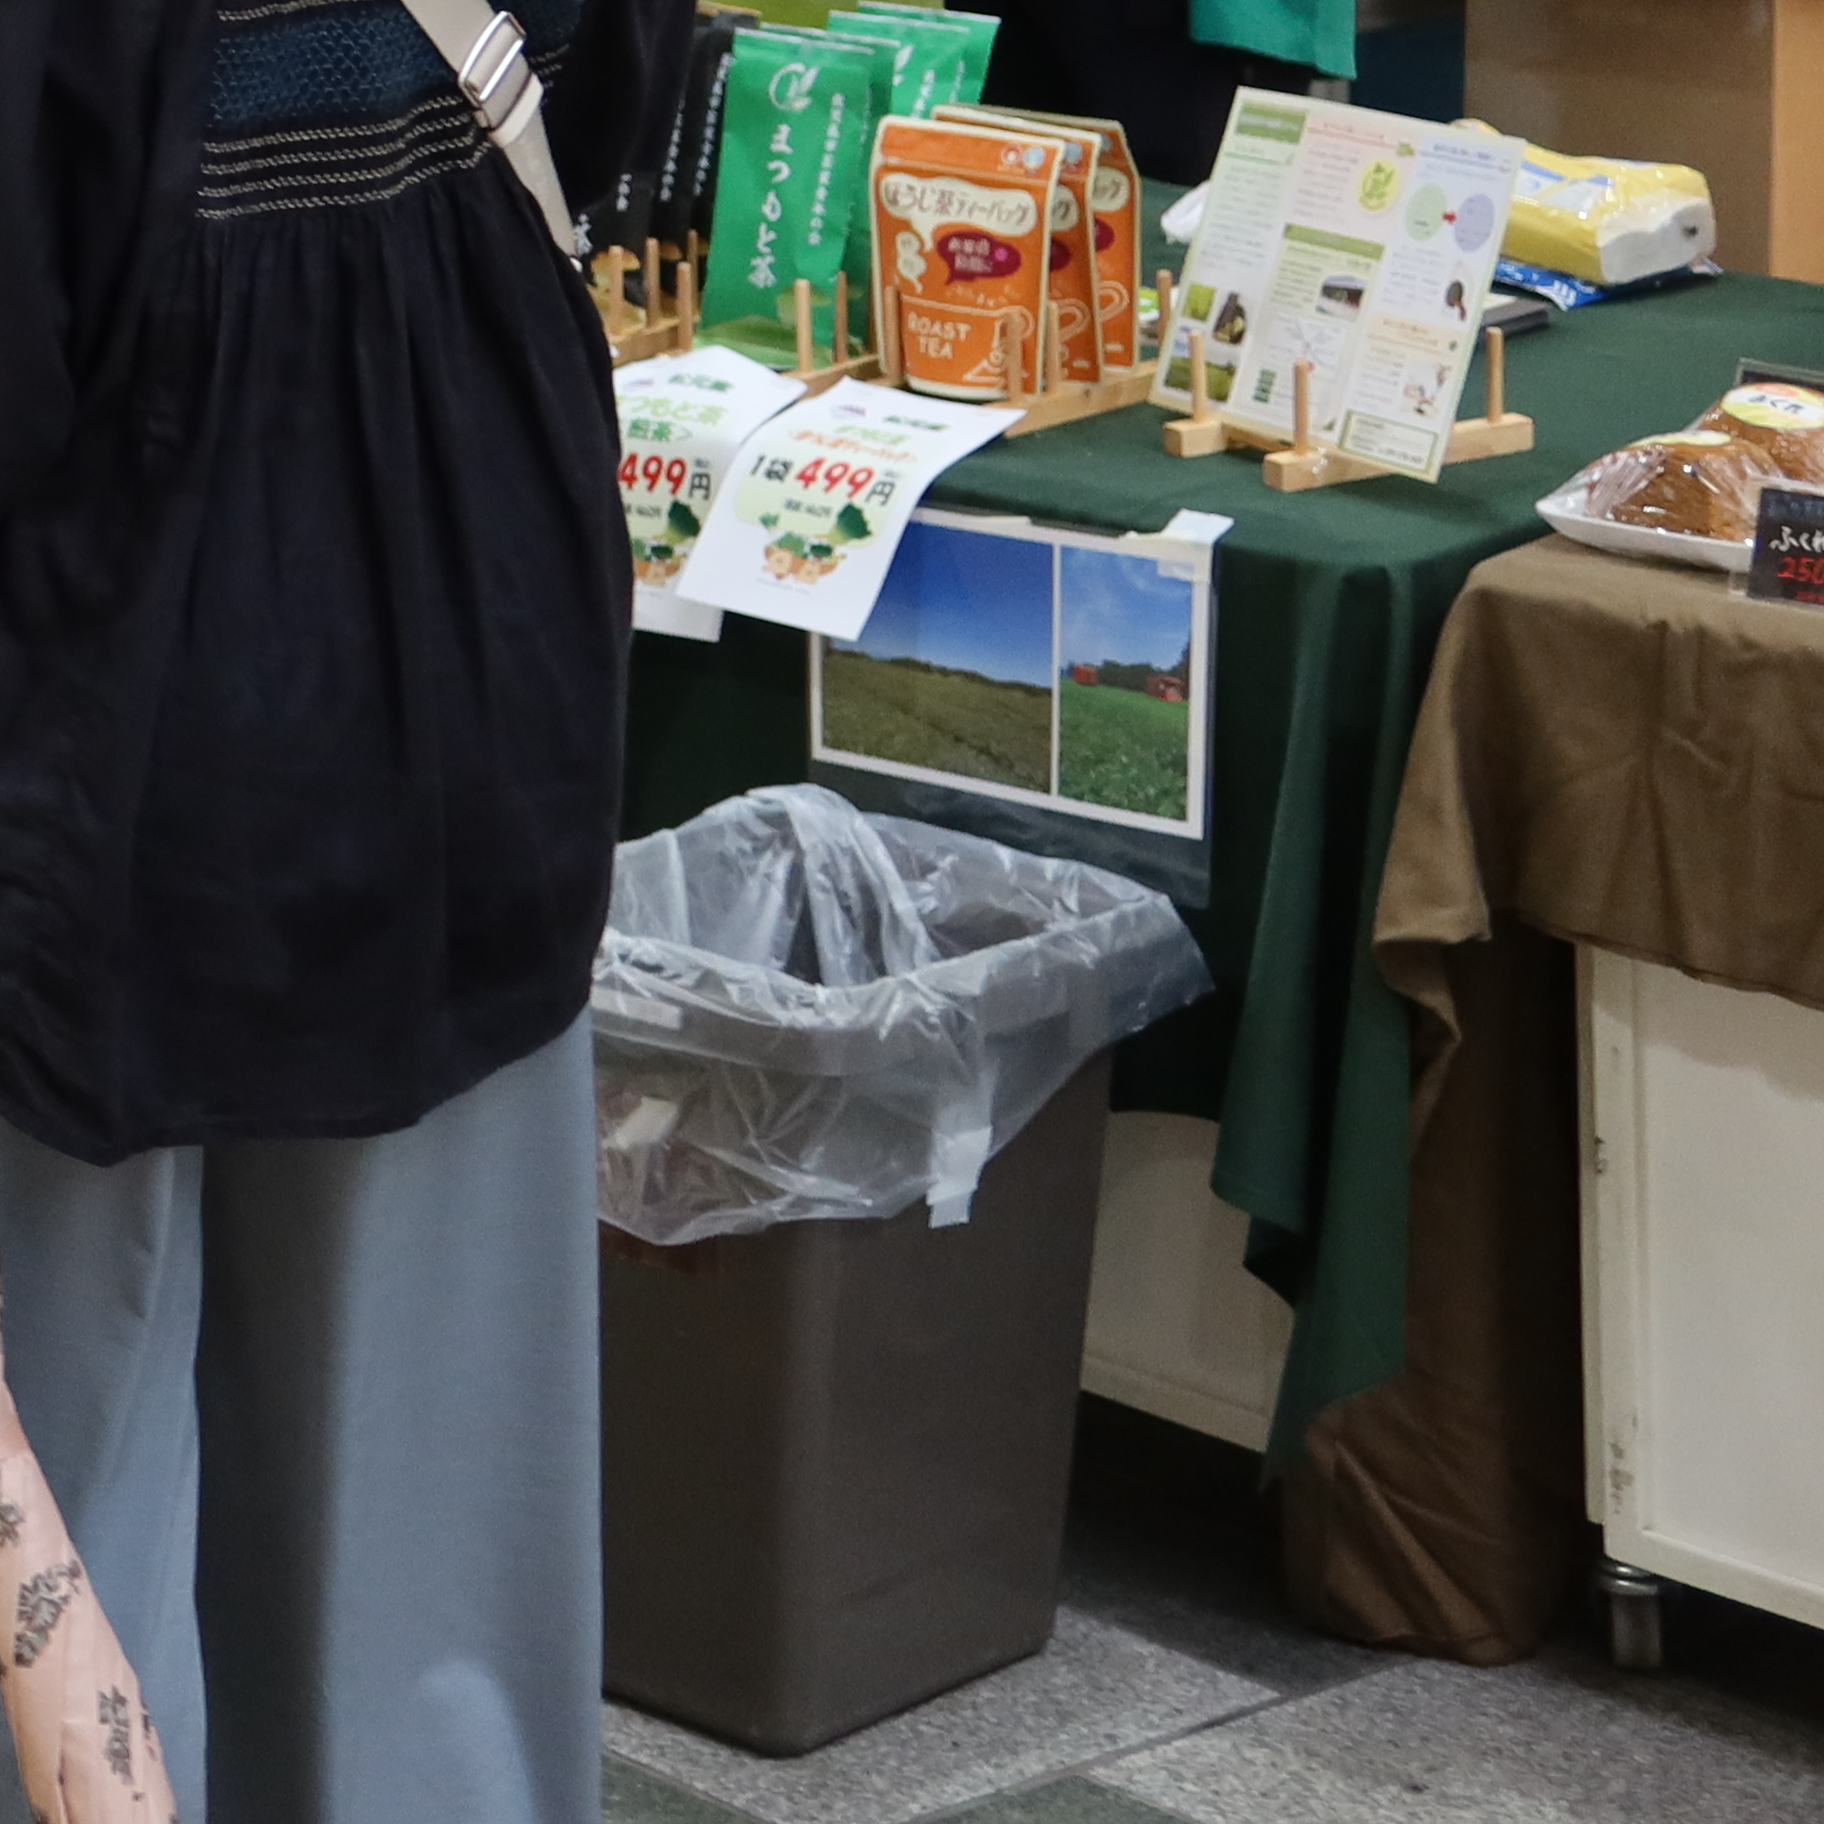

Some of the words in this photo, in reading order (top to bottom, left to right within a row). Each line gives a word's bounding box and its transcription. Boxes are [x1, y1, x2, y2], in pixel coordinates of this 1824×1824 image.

[749, 123, 793, 288] まつもと茶
[907, 312, 972, 342] ROAST
[918, 336, 952, 358] TEA
